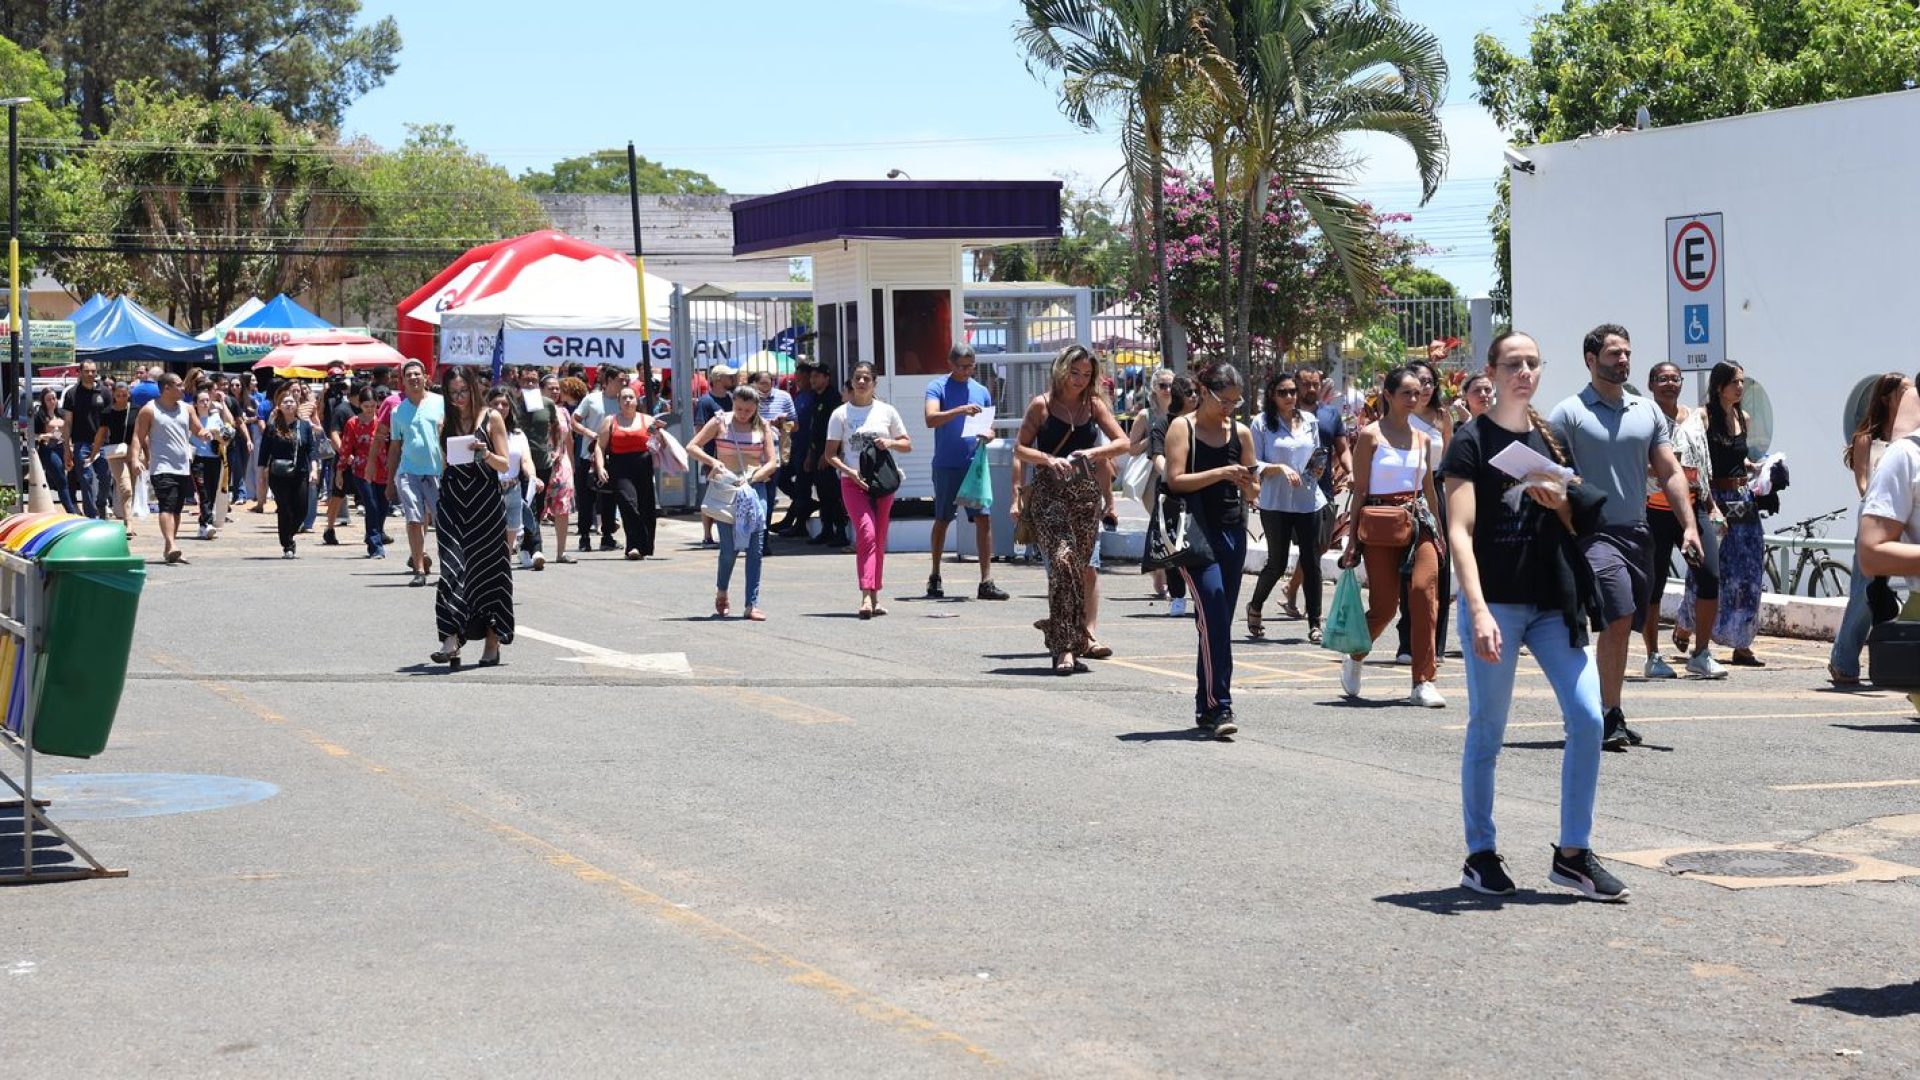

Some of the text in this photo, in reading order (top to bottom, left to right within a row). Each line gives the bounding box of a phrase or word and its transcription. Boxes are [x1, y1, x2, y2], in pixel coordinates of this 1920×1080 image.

[1685, 237, 1706, 280] E
[543, 335, 625, 359] GRAN
[651, 338, 732, 360] GAN
